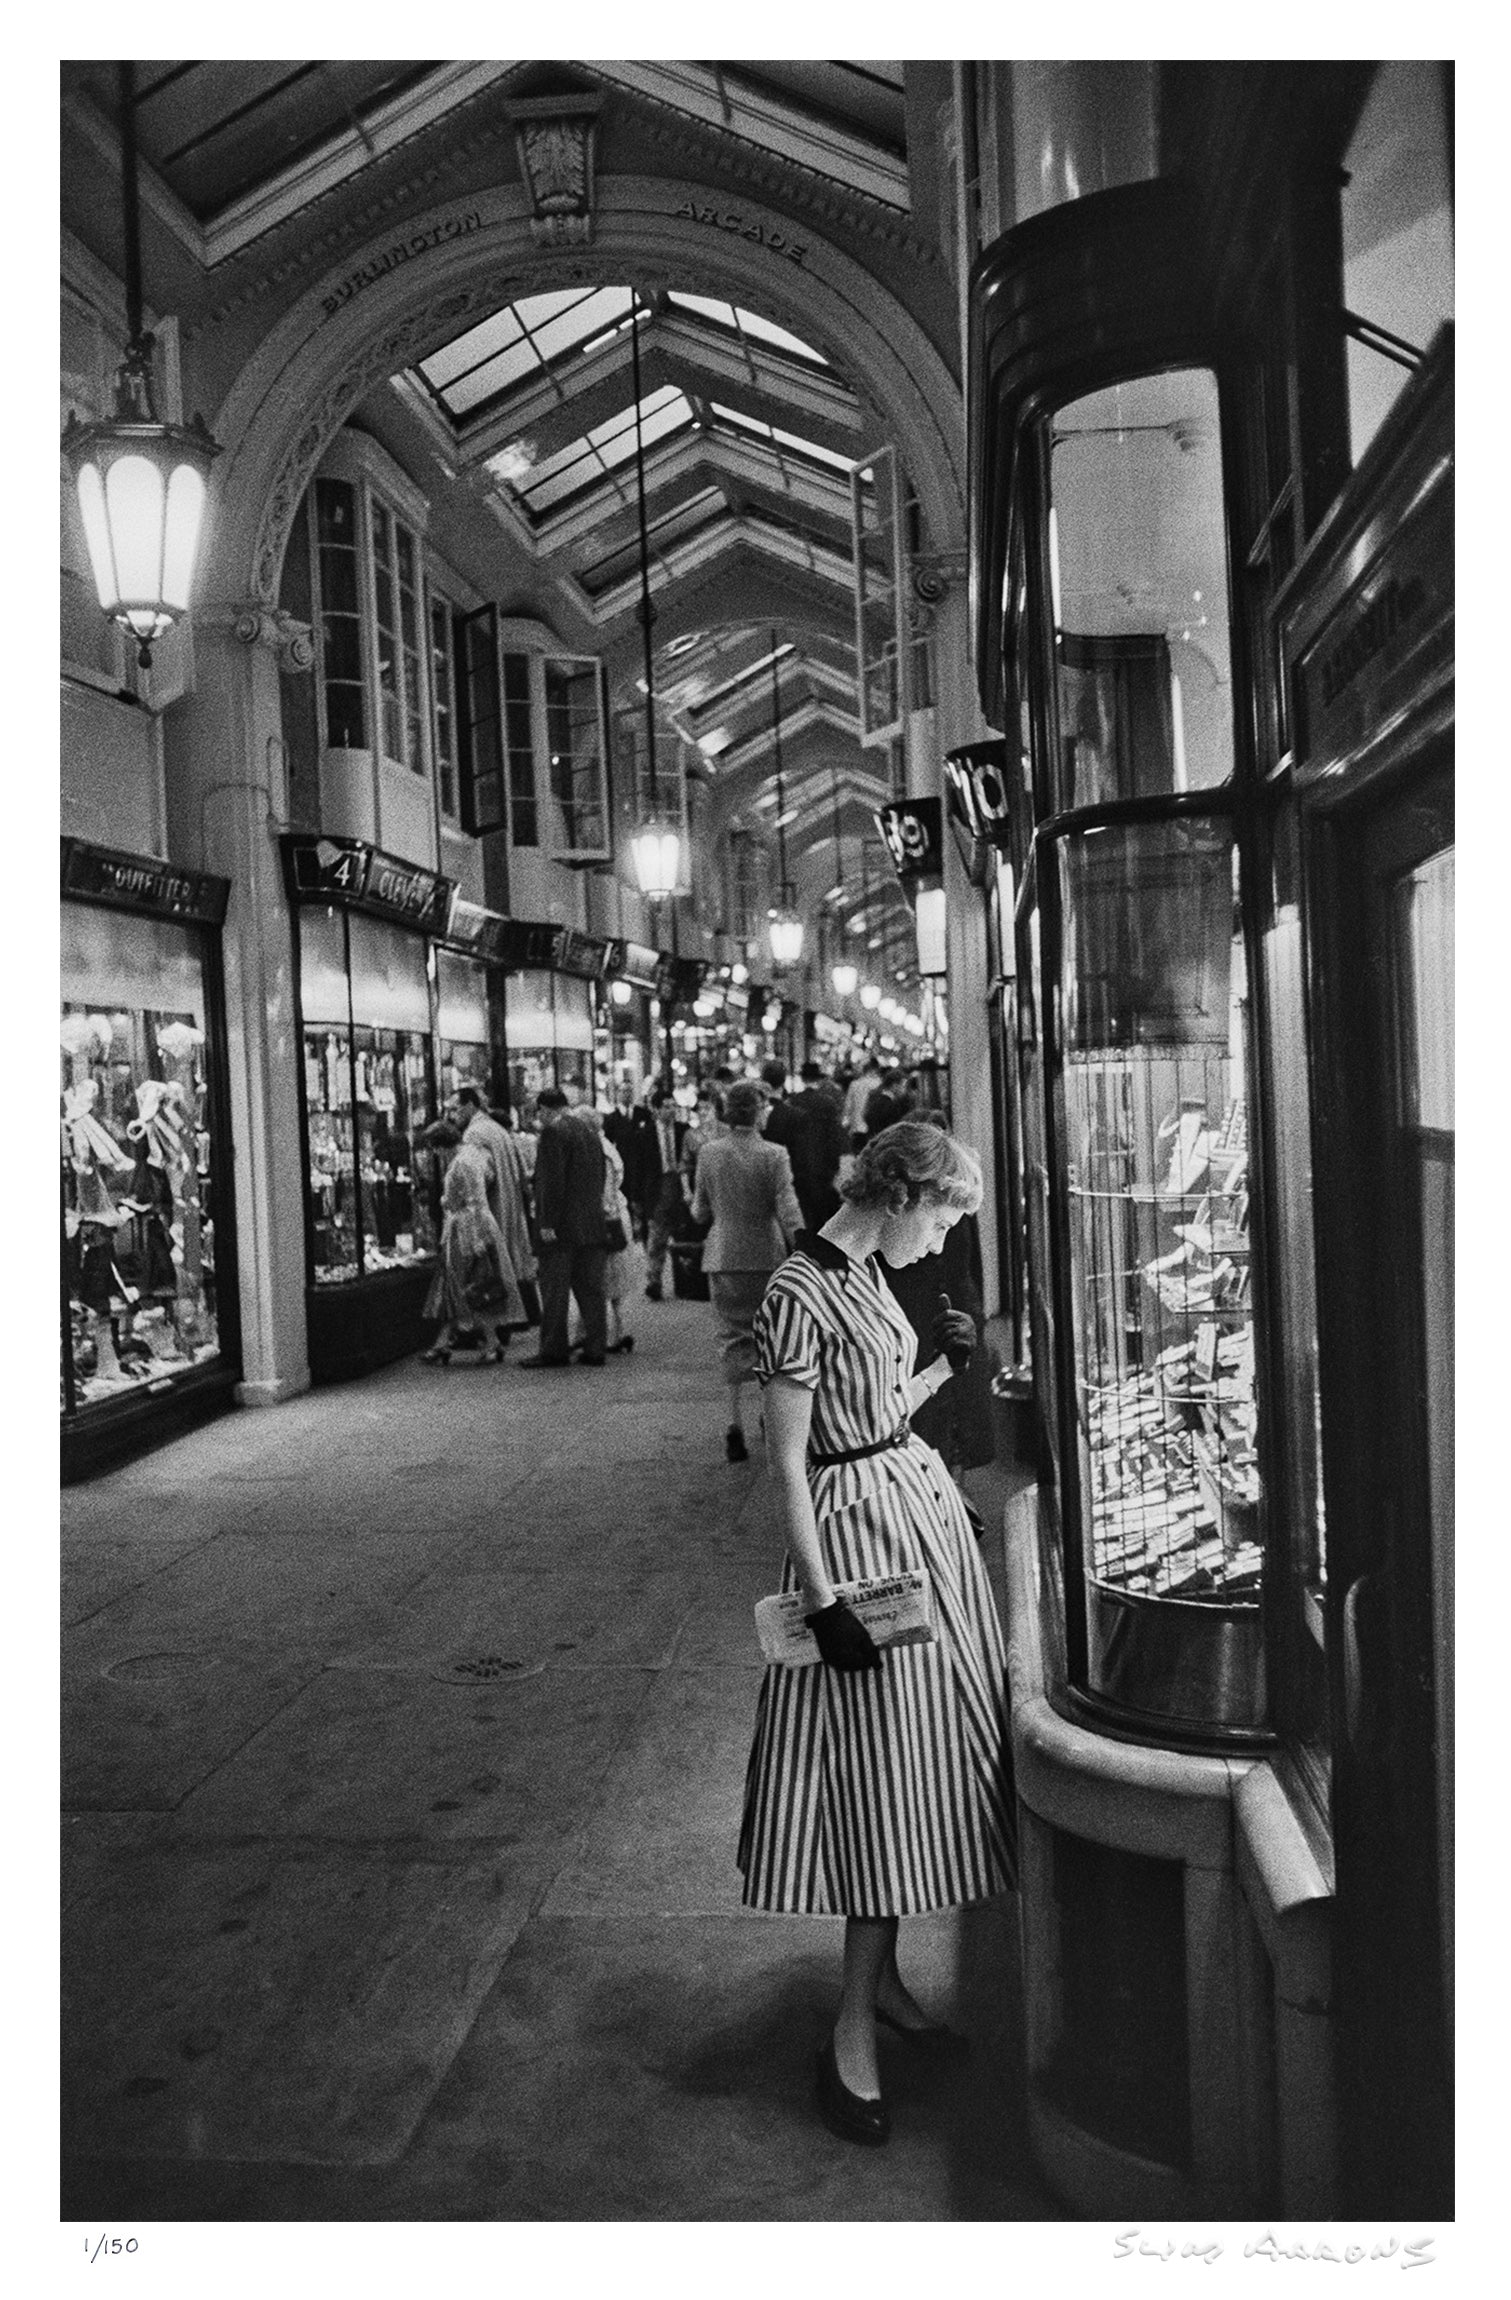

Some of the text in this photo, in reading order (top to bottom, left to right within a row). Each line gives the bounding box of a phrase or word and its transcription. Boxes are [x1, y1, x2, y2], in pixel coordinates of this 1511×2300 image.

[321, 202, 808, 312] BURLINGTON ARCADE
[333, 858, 351, 886] 4
[851, 1582, 903, 1604] BARRETT
